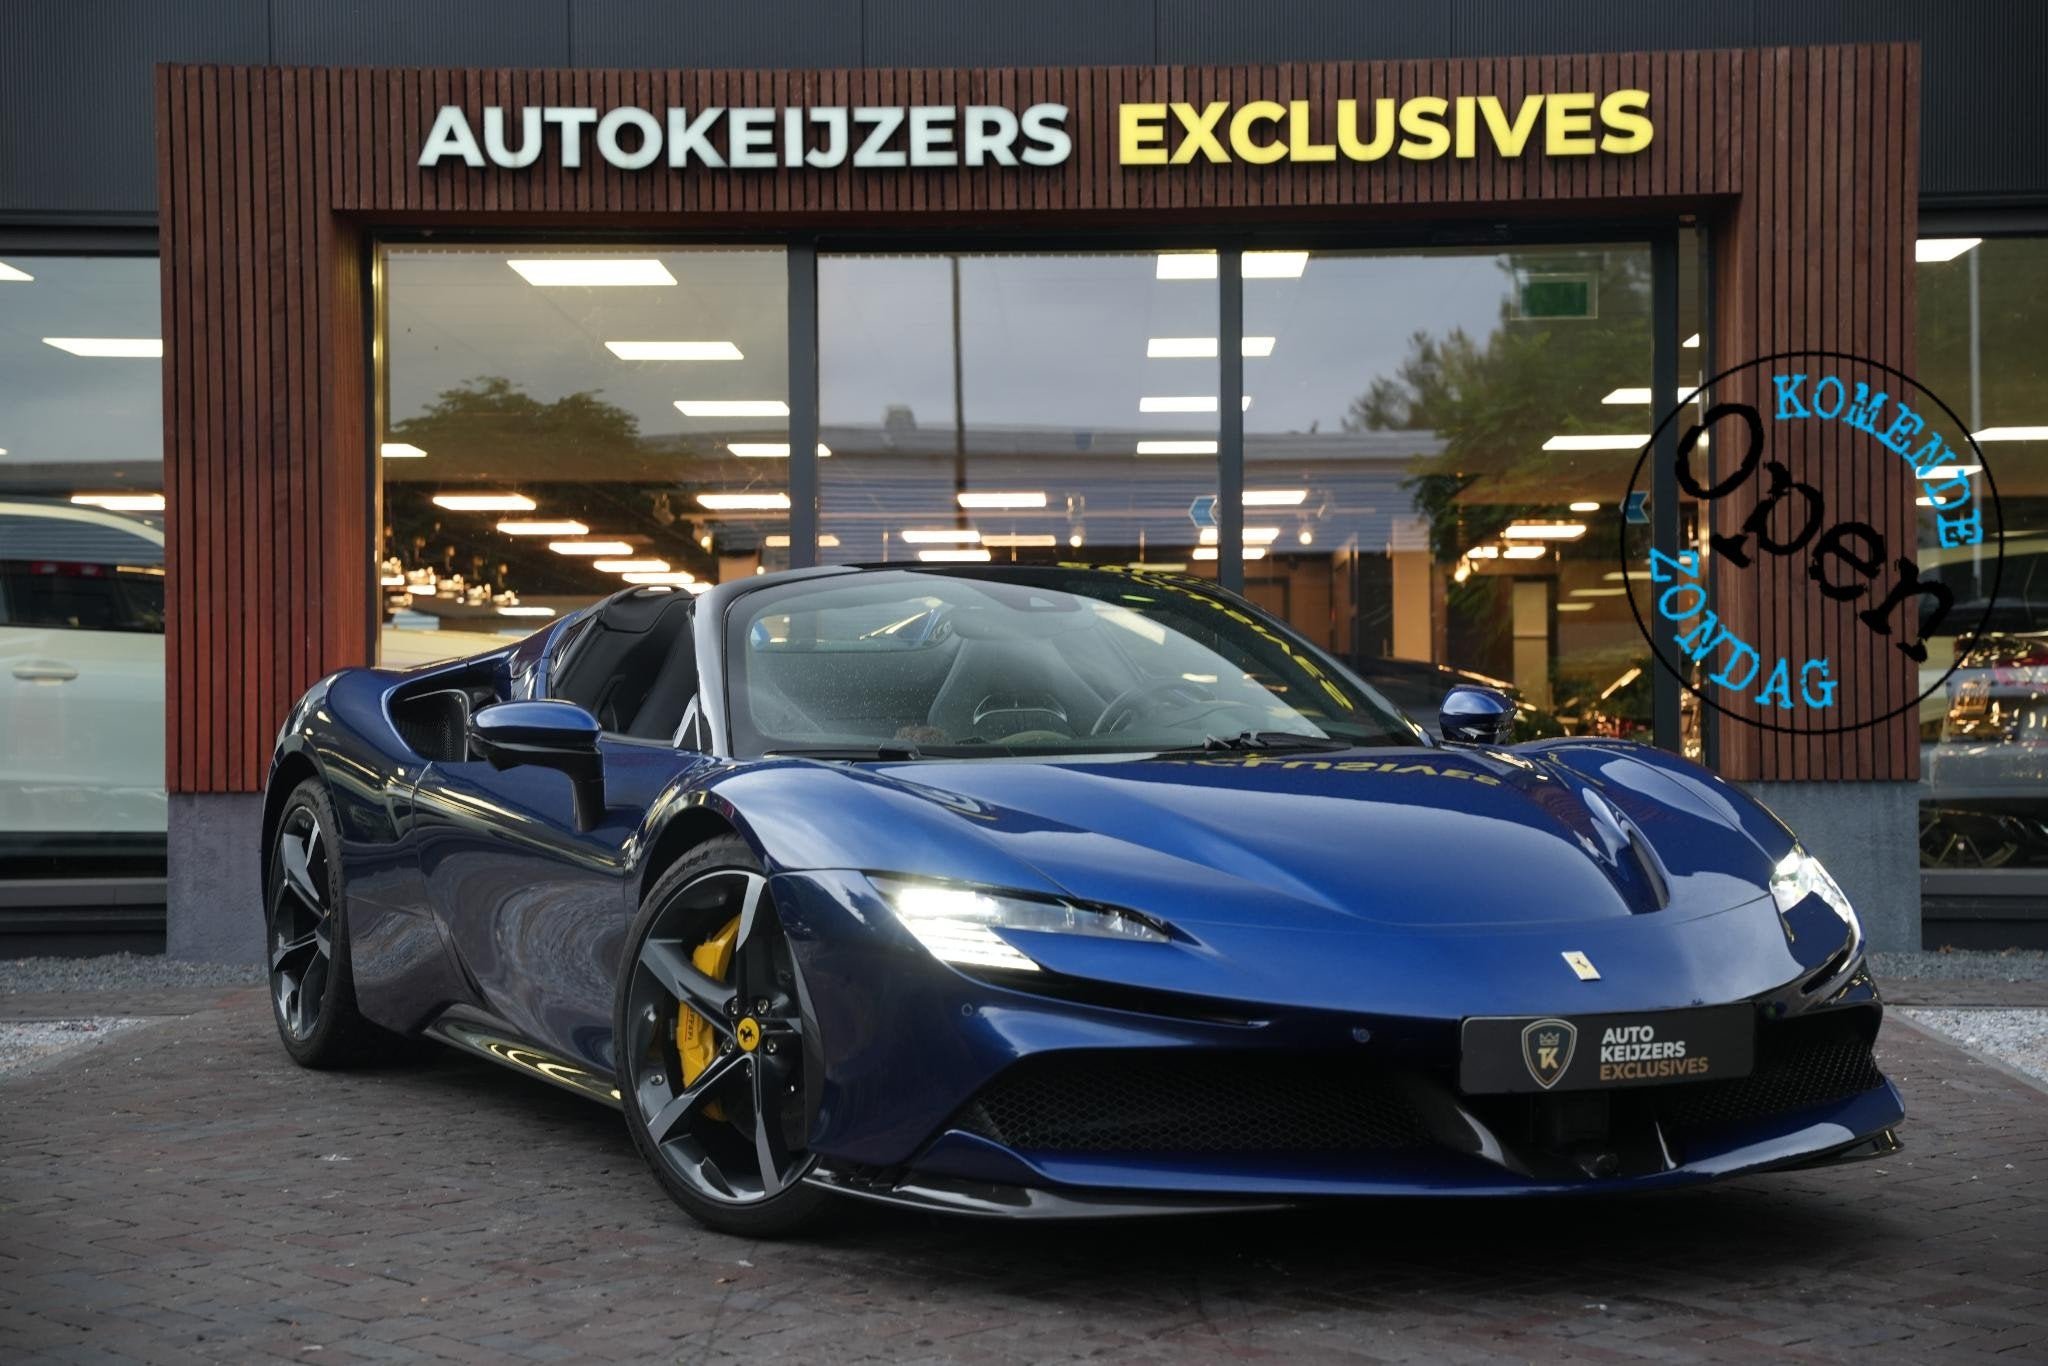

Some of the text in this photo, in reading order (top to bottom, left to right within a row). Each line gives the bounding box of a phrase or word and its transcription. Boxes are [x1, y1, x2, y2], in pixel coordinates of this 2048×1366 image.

[418, 89, 1654, 169] AUTOKEIJZERS EXCLUSIVES
[1602, 1025, 1654, 1045] AUTO
[1600, 1041, 1686, 1063] KEIJZERS
[1600, 1057, 1709, 1081] EXCLUSIVES
